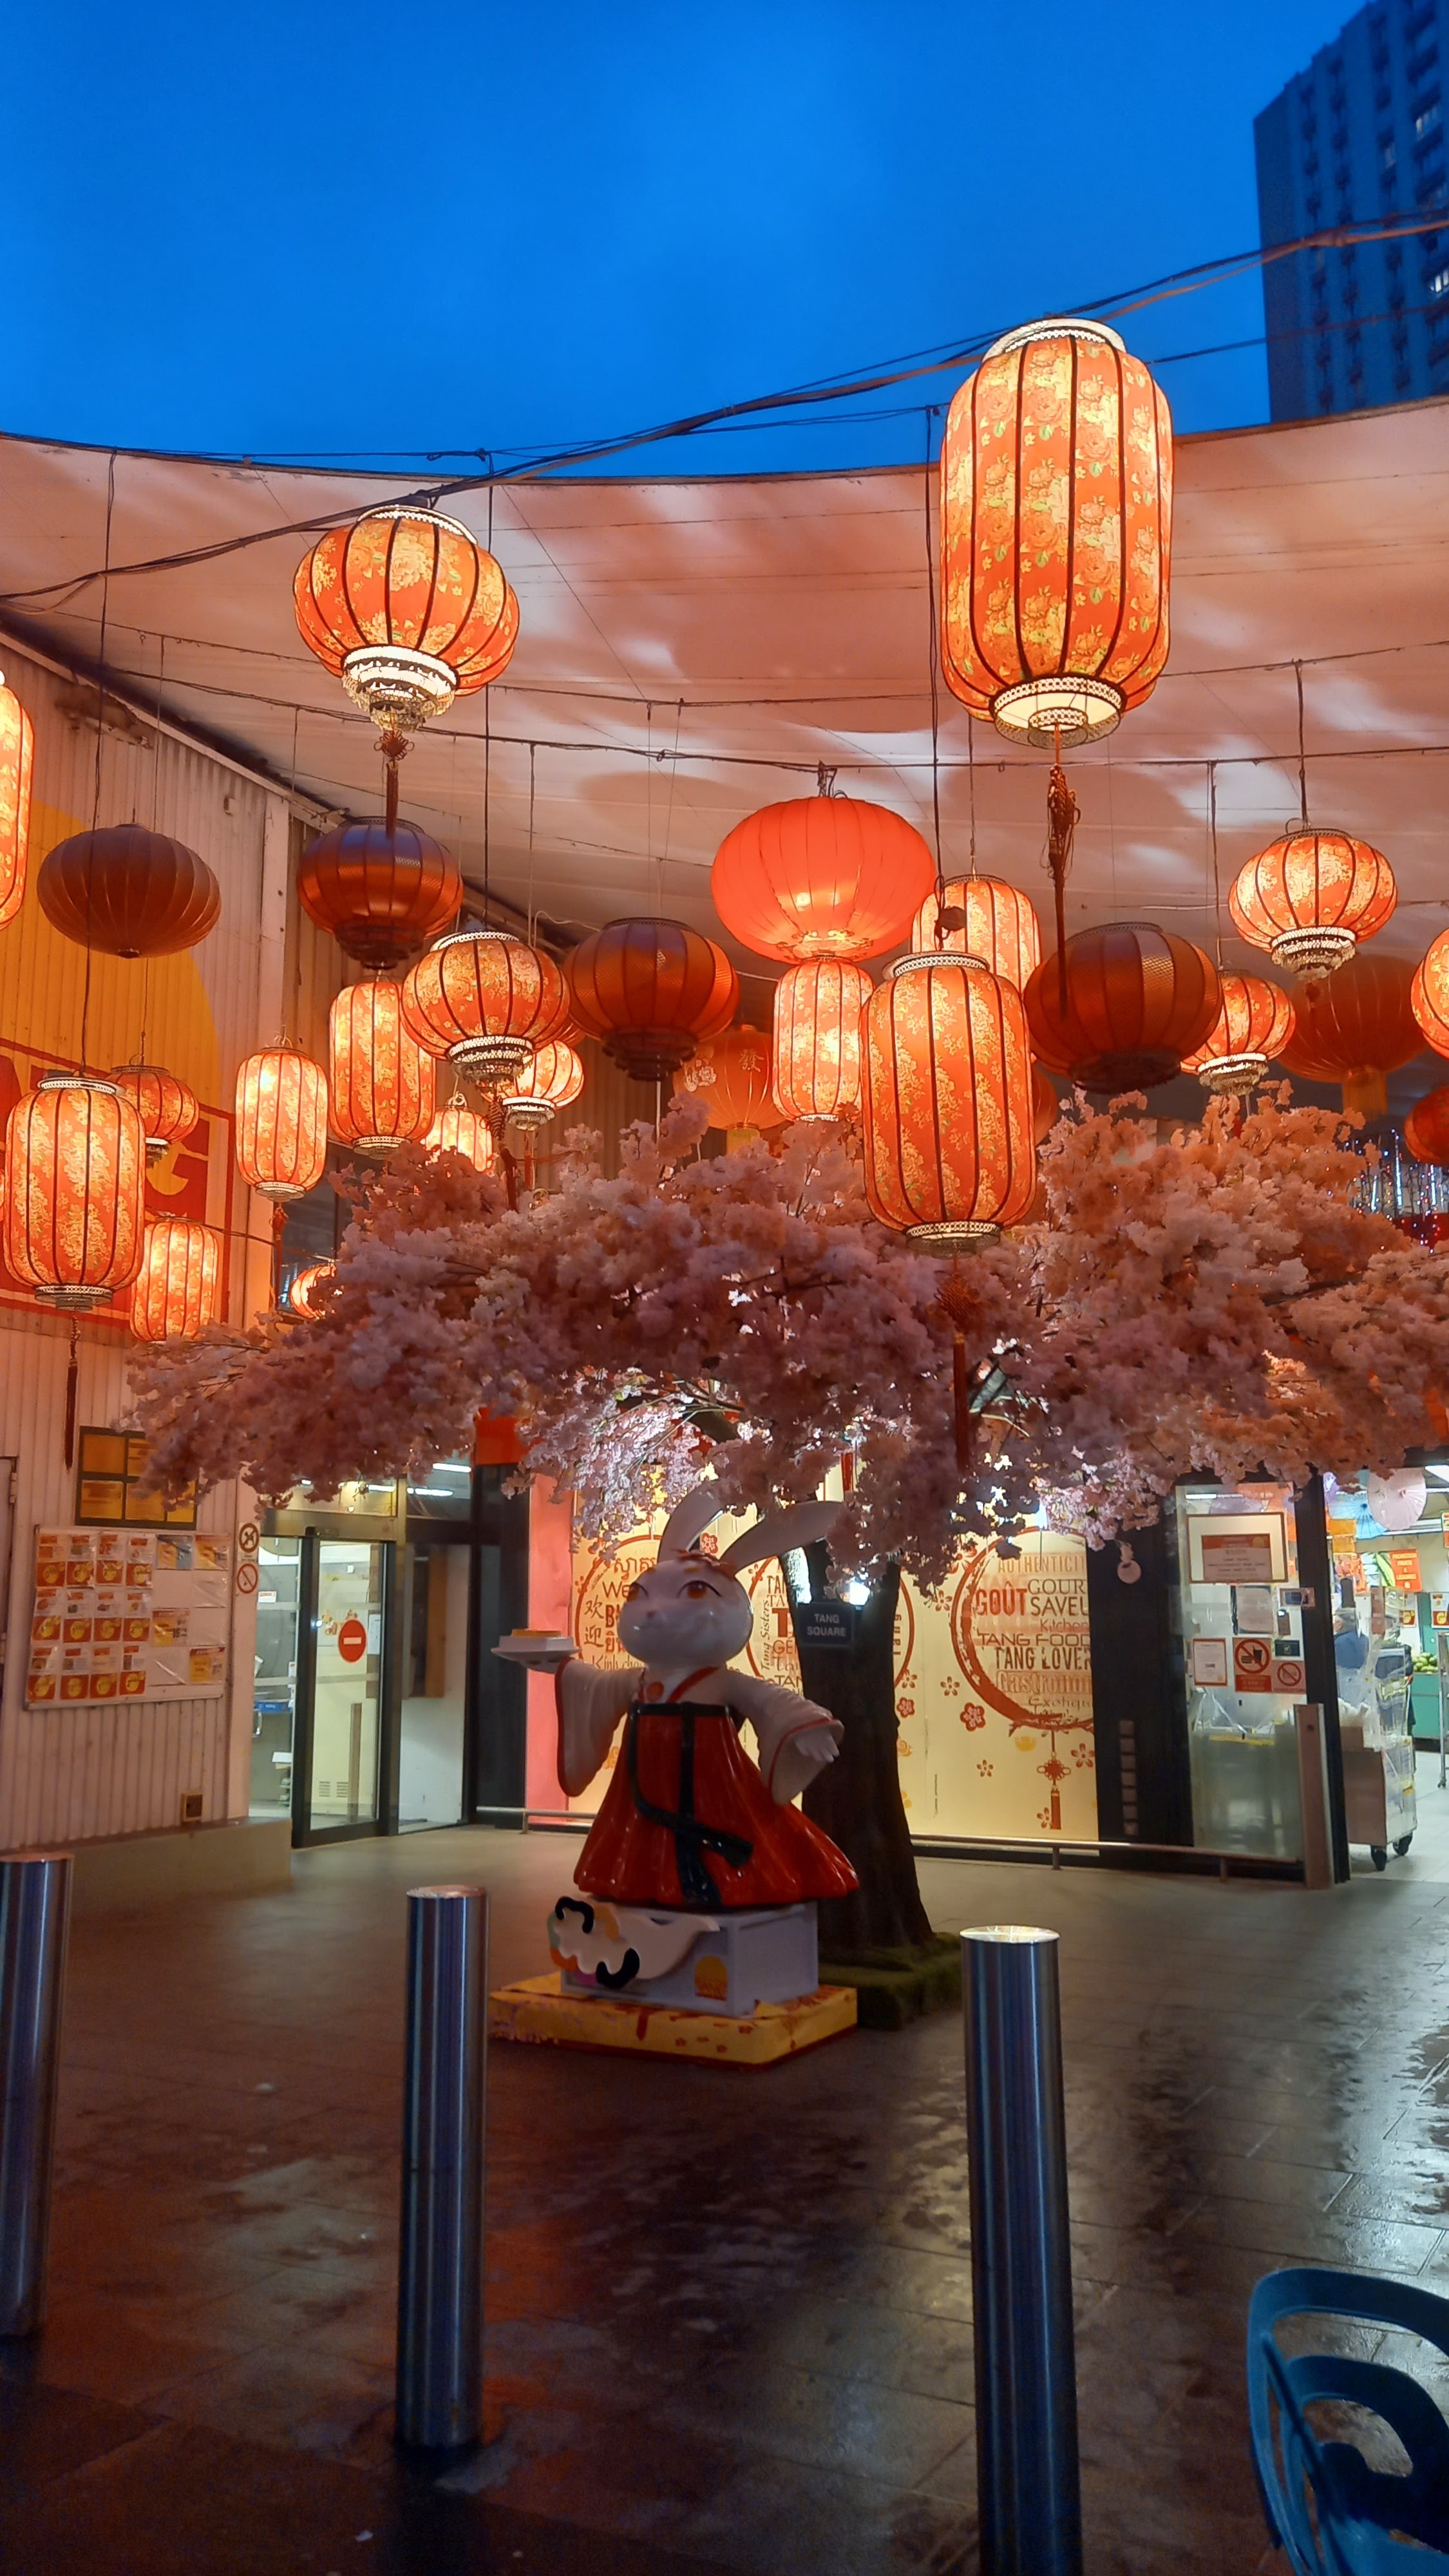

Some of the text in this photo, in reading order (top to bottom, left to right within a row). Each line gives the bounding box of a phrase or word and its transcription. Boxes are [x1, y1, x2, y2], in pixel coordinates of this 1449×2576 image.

[976, 1581, 1027, 1616] GOÛT
[814, 1614, 840, 1624] TANG
[806, 1626, 846, 1636] SQUARE
[978, 1633, 1030, 1646] TANG
[996, 1646, 1035, 1670] TANG
